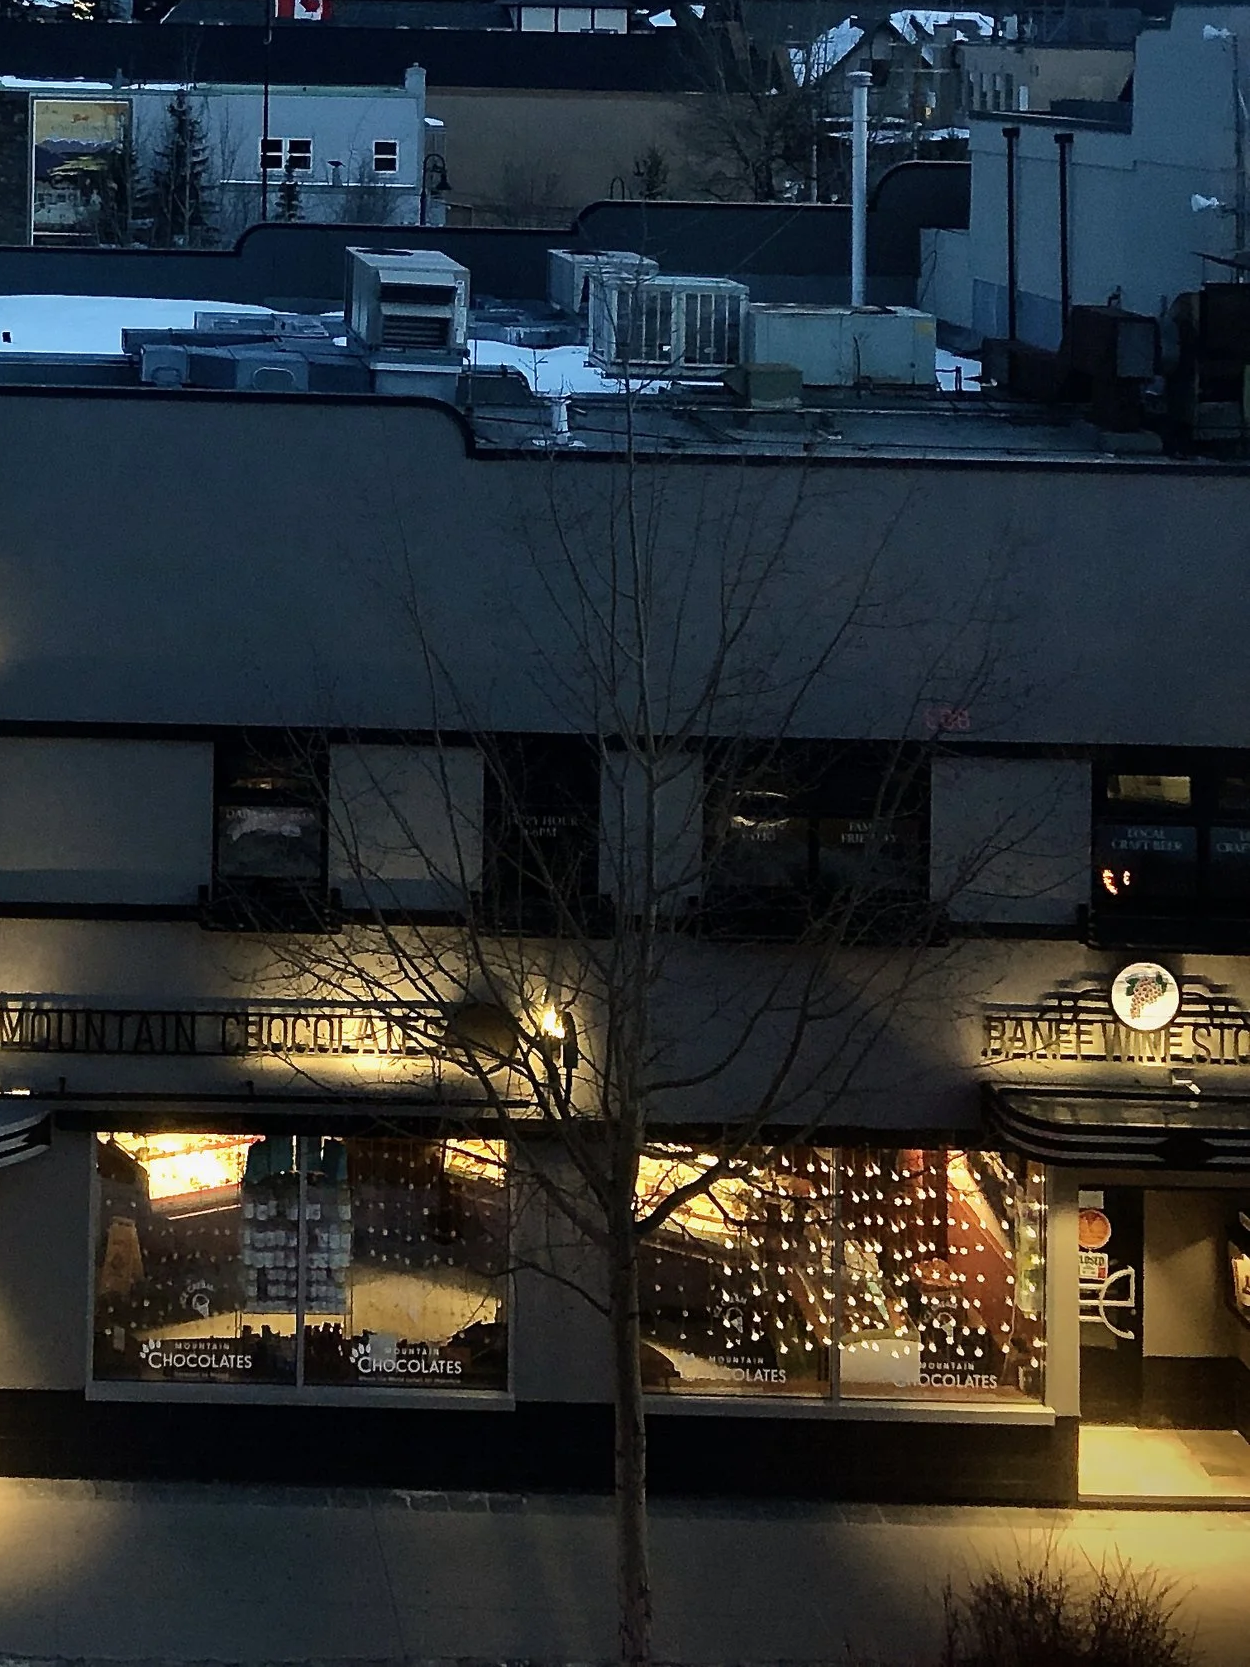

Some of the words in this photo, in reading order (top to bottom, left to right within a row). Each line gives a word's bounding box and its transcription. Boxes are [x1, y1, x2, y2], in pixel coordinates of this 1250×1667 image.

[541, 815, 579, 827] HOUR
[1126, 828, 1166, 840] LOCAL
[1111, 839, 1150, 851] CRAFT
[1152, 840, 1183, 852] BEER
[985, 1017, 1095, 1062] BANFF
[1101, 1023, 1183, 1066] WINE
[175, 1342, 230, 1351] MOUNTAIN
[384, 1347, 440, 1357] MOUNTAIN
[148, 1352, 253, 1370] CHOCOLATES
[357, 1356, 463, 1375] CHOCOLATES
[709, 1355, 765, 1365] MOUNTAIN
